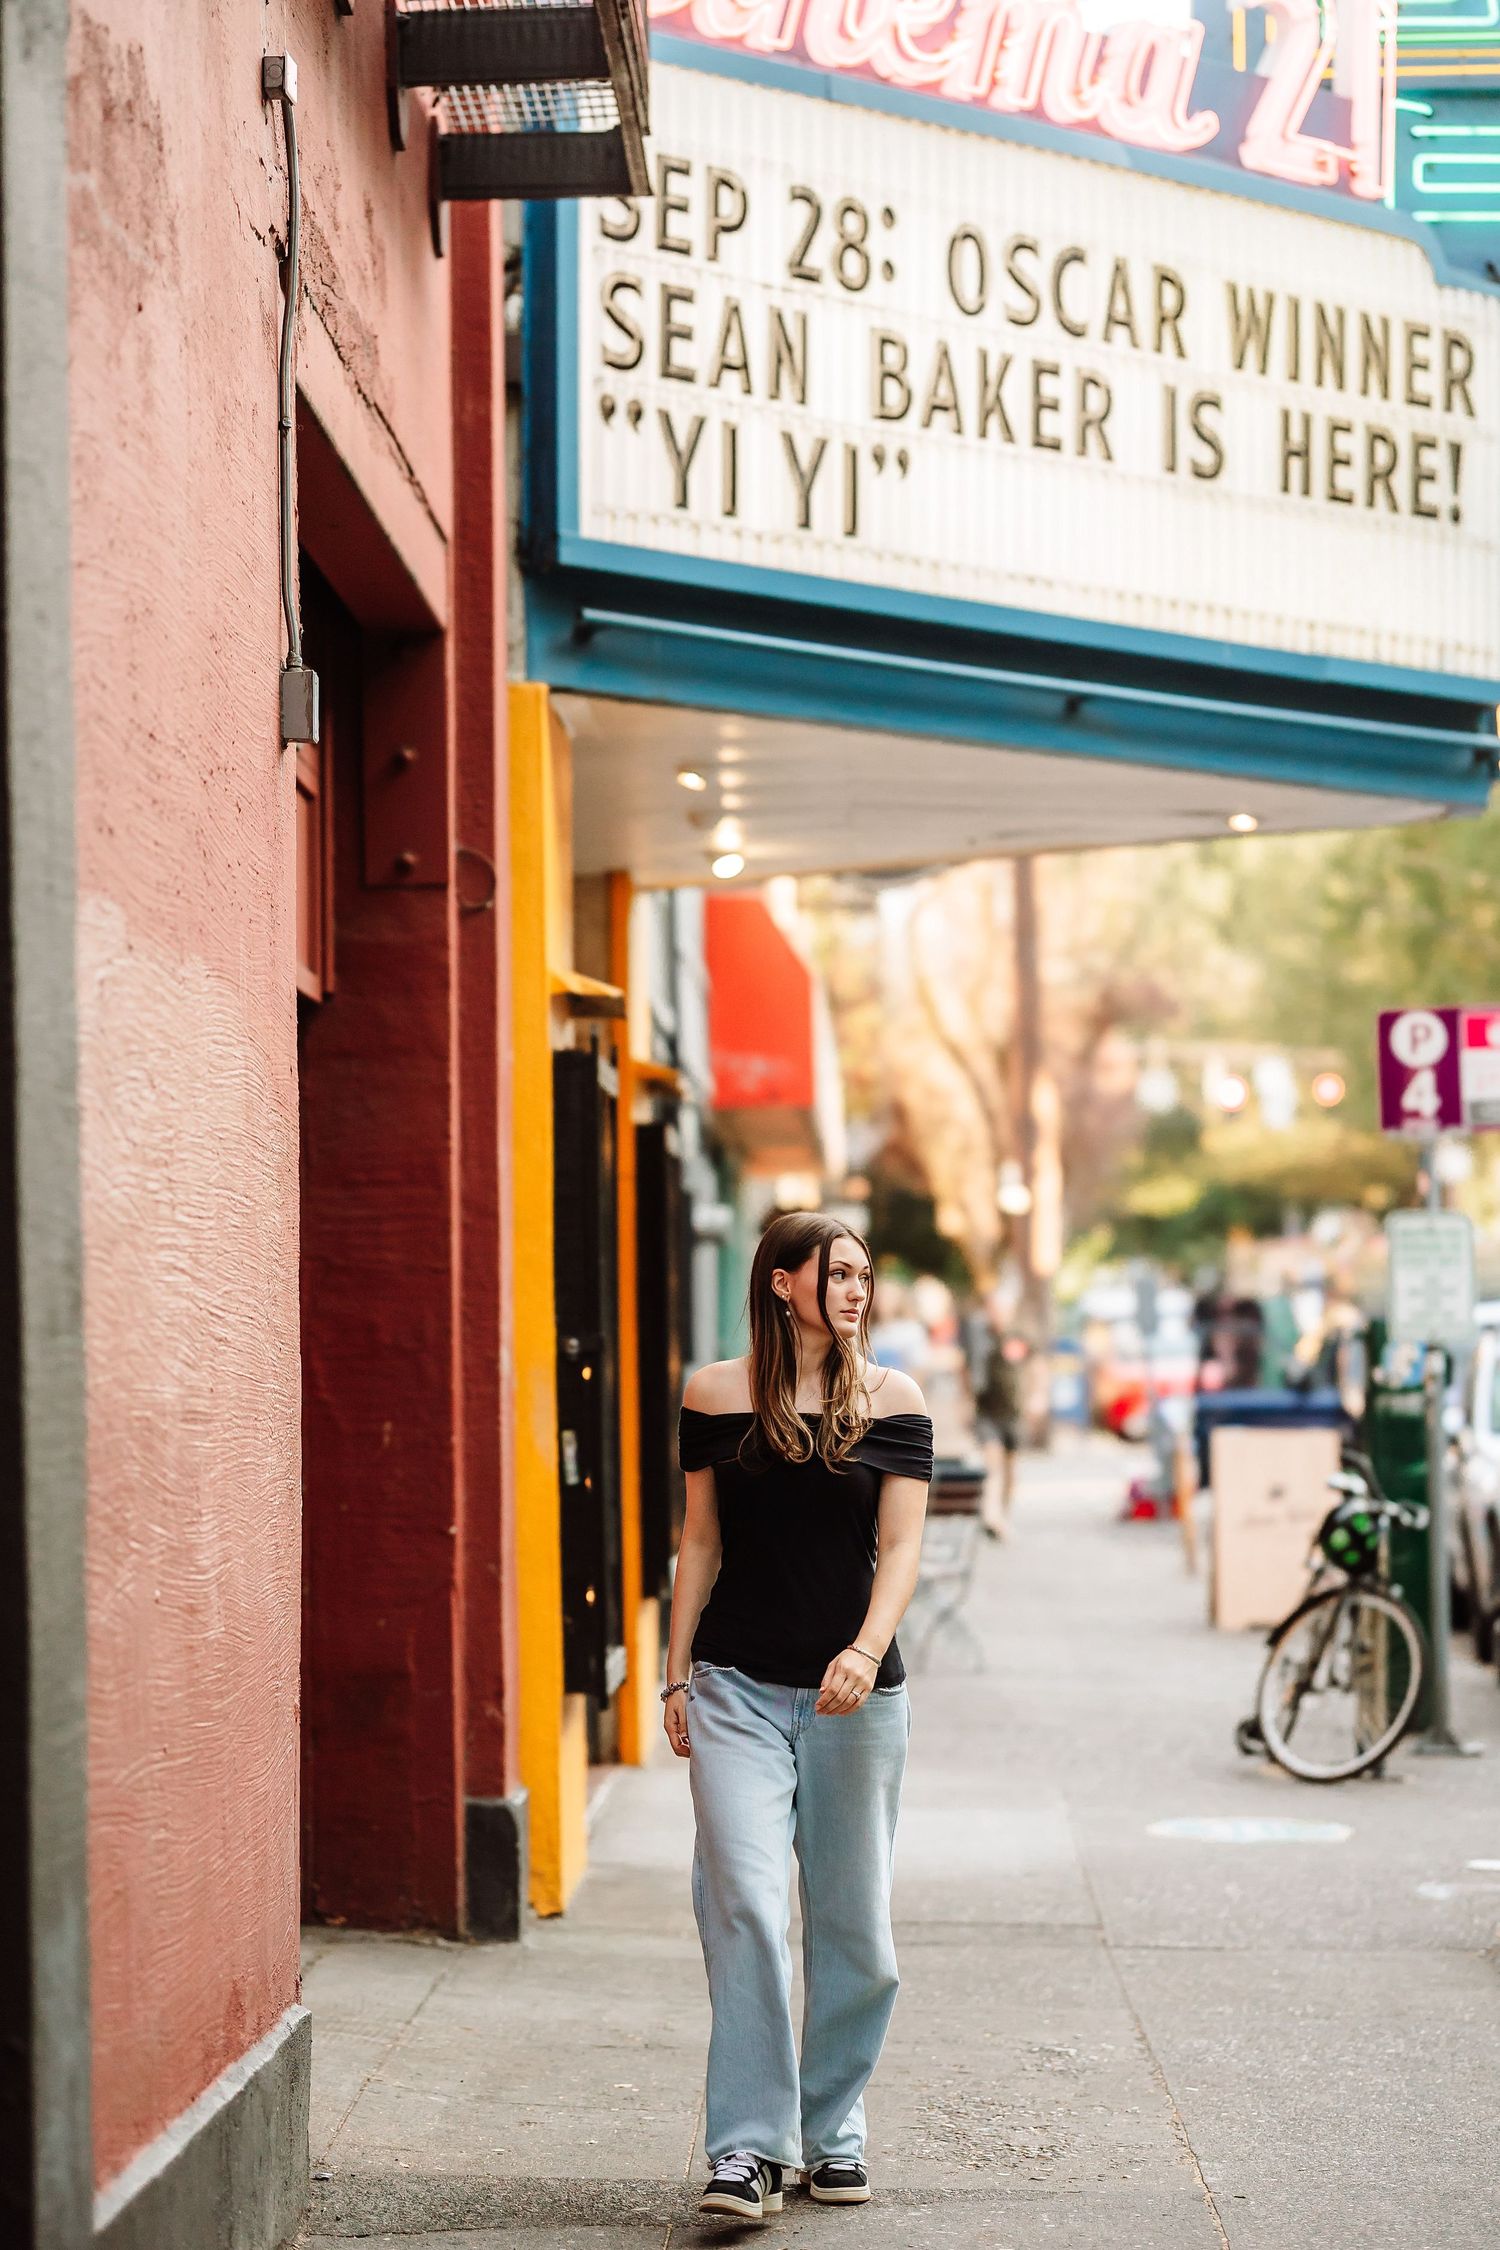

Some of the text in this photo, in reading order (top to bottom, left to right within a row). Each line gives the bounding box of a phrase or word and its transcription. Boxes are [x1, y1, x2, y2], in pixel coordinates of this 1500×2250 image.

[1230, 0, 1397, 201] 21
[787, 184, 897, 292] 28:
[947, 223, 1188, 361] OSCAR
[1225, 279, 1476, 418] WINNER
[600, 271, 1463, 524] SEAN BAKER IS HERE!
[600, 393, 910, 538] "YI YI"
[1400, 1067, 1442, 1119] 4
[1410, 1022, 1433, 1055] P
